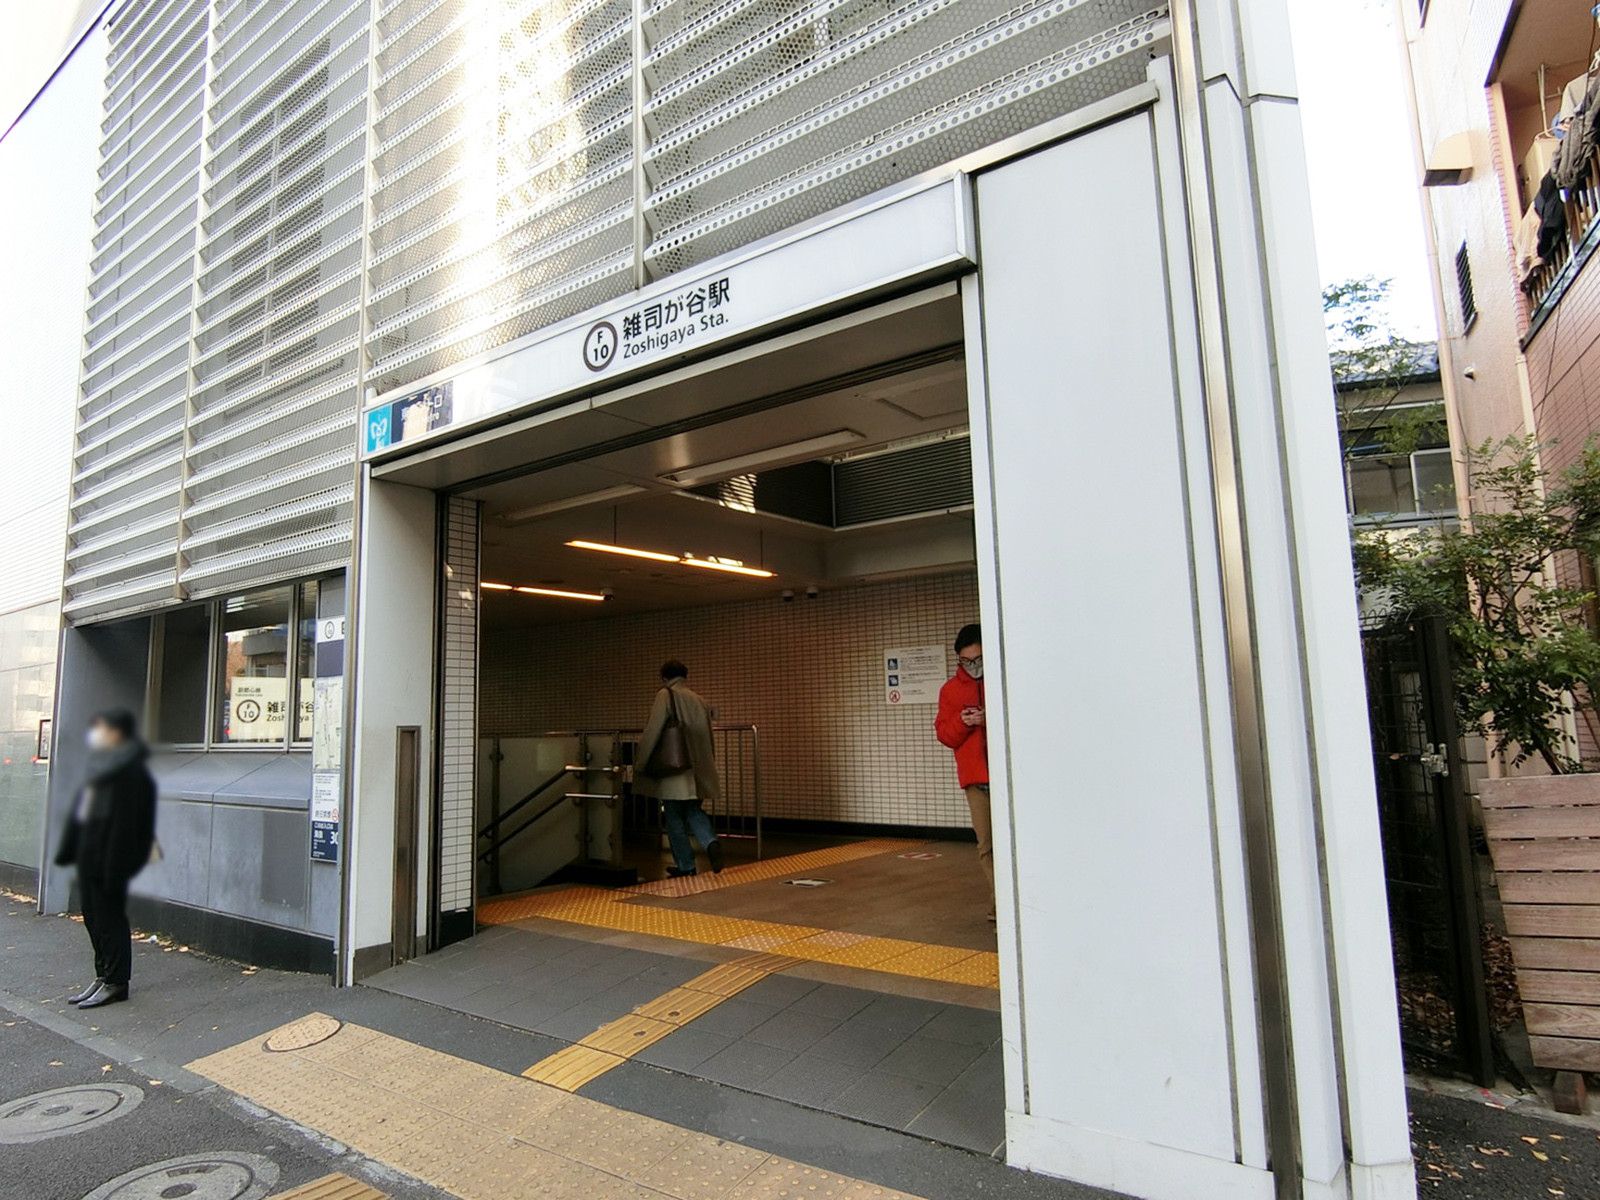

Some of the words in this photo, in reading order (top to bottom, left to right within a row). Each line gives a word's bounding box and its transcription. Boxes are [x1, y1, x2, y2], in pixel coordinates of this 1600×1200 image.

[623, 277, 730, 341] 雑司が谷駅
[597, 330, 603, 344] F
[623, 322, 695, 359] Zoshigaya
[700, 312, 729, 331] Sta.
[593, 344, 609, 362] 10
[267, 701, 314, 713] 雑谷
